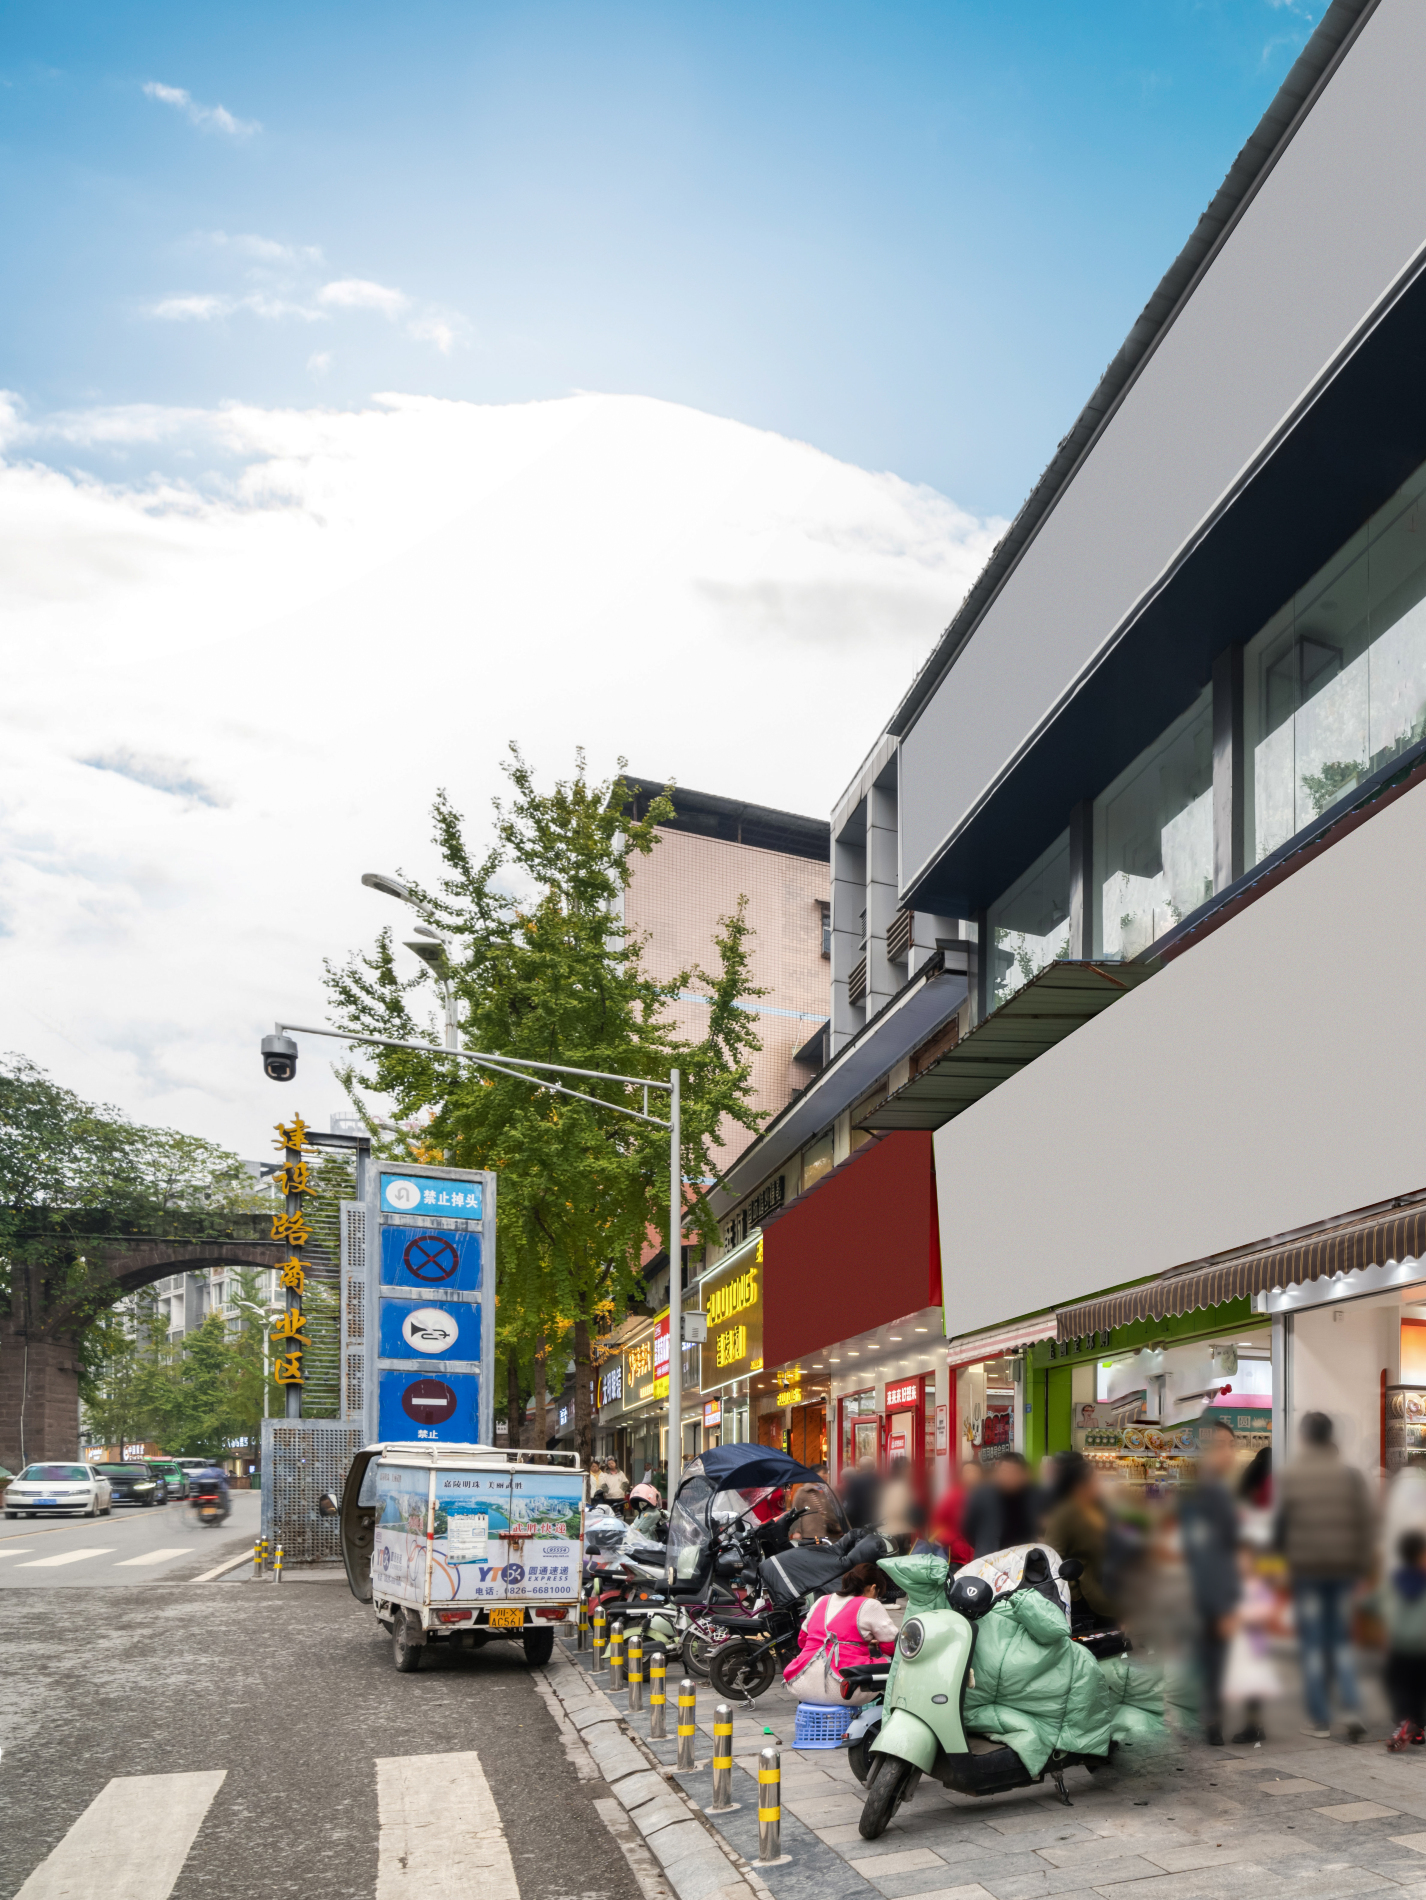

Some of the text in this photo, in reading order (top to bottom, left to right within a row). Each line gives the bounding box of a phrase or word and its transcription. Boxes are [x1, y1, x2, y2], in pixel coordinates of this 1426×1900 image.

[423, 1189, 478, 1209] 禁止掉头
[270, 1111, 319, 1386] 建设路商业区
[417, 1429, 439, 1440] 禁止
[444, 1480, 523, 1489] 嘉陵明珠 美丽武胜
[512, 1522, 567, 1534] 武胜快递
[528, 1566, 569, 1576] 圆通速递
